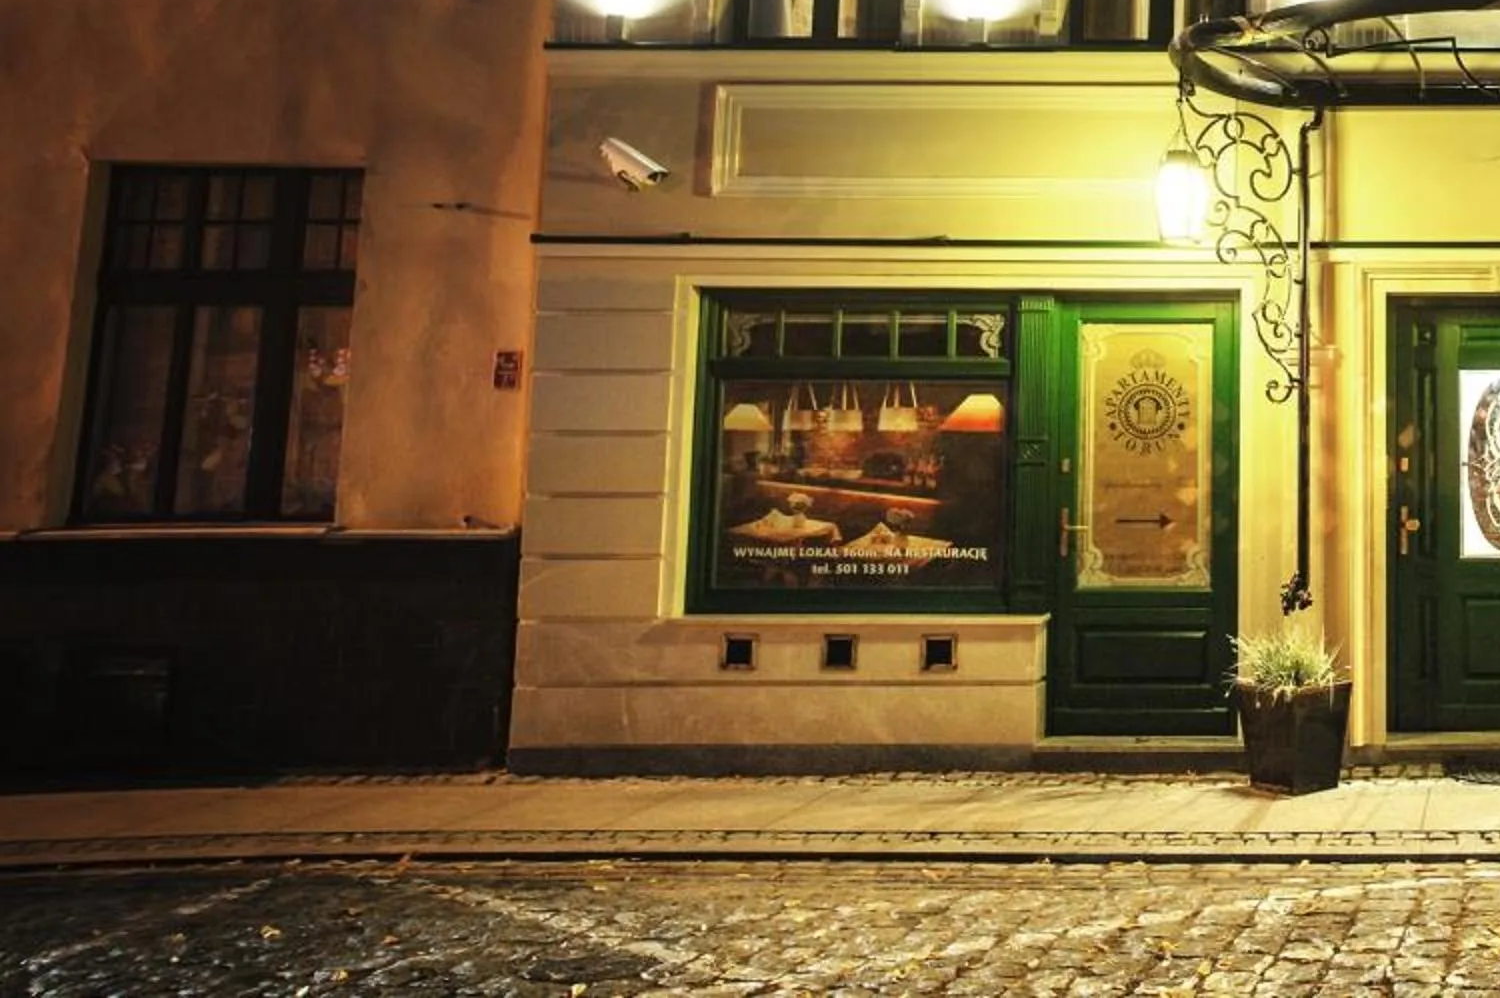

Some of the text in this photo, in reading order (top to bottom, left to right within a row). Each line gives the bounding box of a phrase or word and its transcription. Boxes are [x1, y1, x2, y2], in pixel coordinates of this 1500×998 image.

[733, 546, 797, 561] WYNAJMĘ
[799, 547, 838, 558] LOKAL
[835, 563, 858, 575] 501
[886, 563, 910, 575] 011
